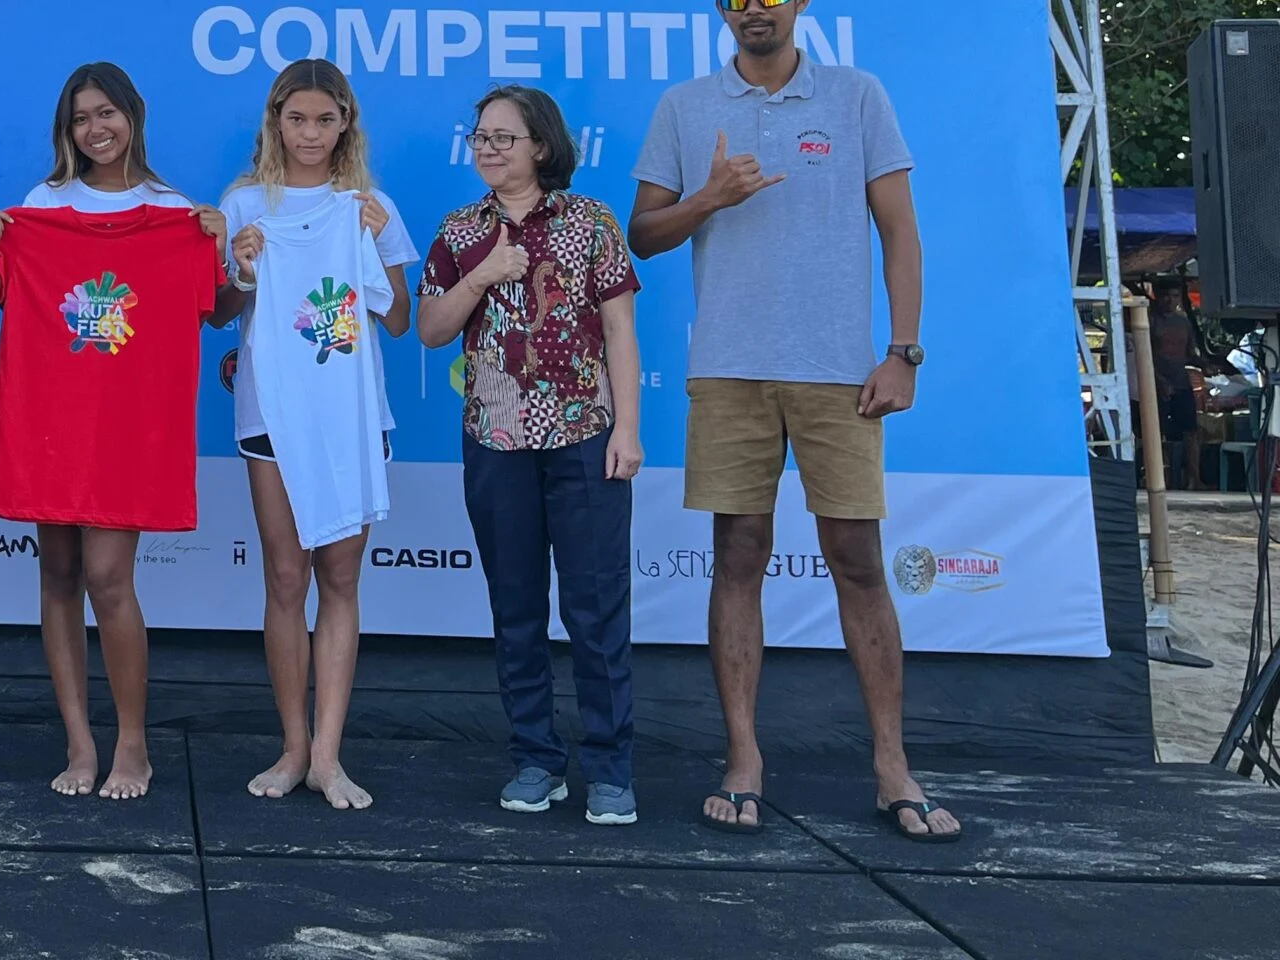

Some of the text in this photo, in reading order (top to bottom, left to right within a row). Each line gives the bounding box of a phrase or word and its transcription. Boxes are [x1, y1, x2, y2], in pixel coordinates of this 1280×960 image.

[78, 304, 125, 321] KUTA
[310, 305, 353, 331] KUTA
[78, 319, 125, 337] FEST
[143, 554, 158, 564] the
[160, 556, 177, 565] sea
[371, 548, 473, 570] CASIO
[667, 550, 715, 578] SENZ
[764, 553, 830, 578] GUE
[937, 558, 1000, 575] SINGARAJA
